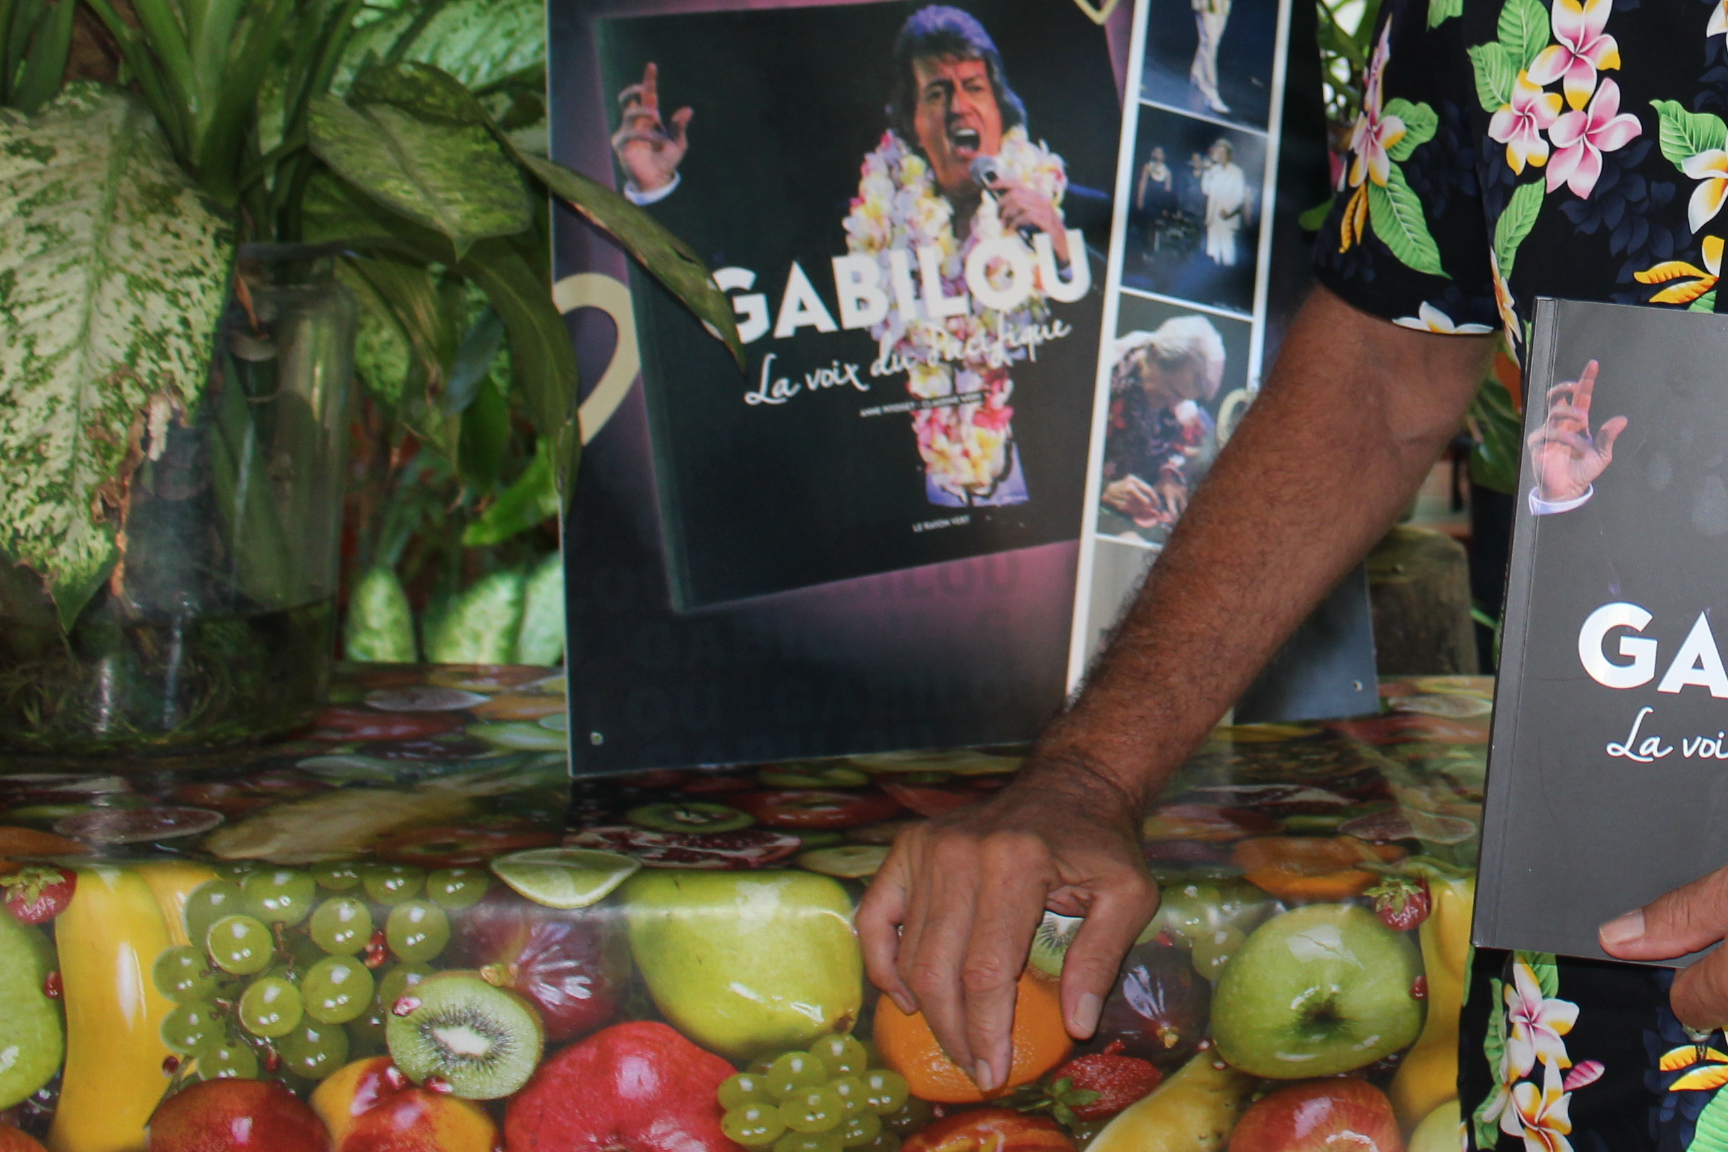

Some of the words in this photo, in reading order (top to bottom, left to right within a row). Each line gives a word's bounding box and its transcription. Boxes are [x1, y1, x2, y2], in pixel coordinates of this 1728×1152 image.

[701, 229, 1092, 344] GABILOU
[744, 352, 801, 405] La
[805, 359, 870, 391] voix
[871, 331, 919, 377] du
[925, 319, 1071, 367] Pacifique
[1606, 706, 1674, 763] La
